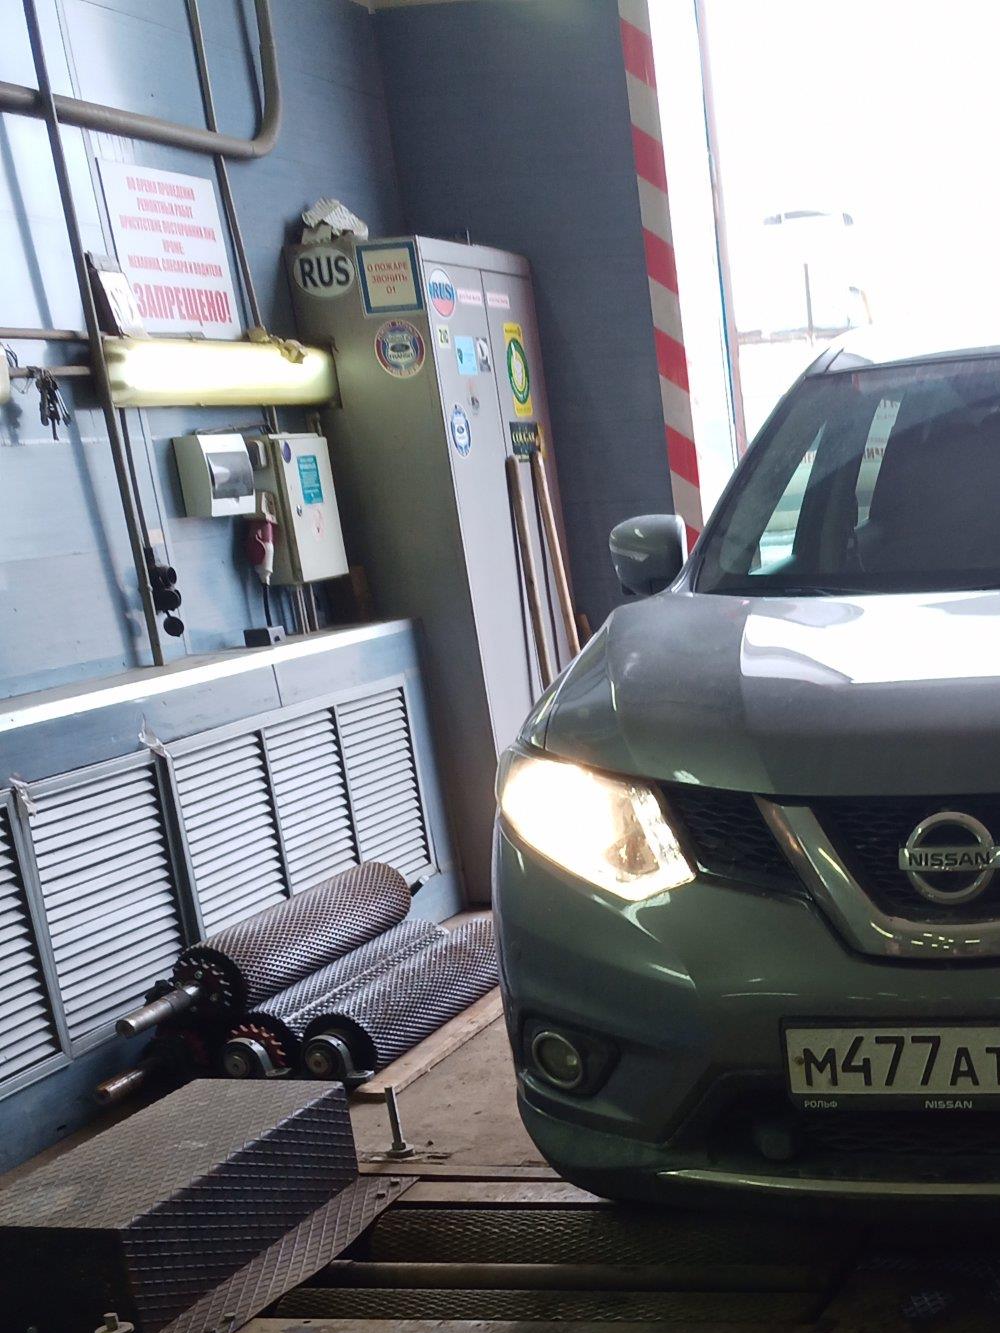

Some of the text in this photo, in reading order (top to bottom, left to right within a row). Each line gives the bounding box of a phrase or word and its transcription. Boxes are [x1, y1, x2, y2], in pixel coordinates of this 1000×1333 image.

[299, 255, 349, 288] RUS
[431, 281, 453, 299] RUS
[133, 282, 232, 326] ЗАПРЕЩЕНО!
[908, 851, 990, 867] NISSAN
[804, 1100, 838, 1109] РОЛЬФ
[924, 1100, 973, 1109] NISSAN
